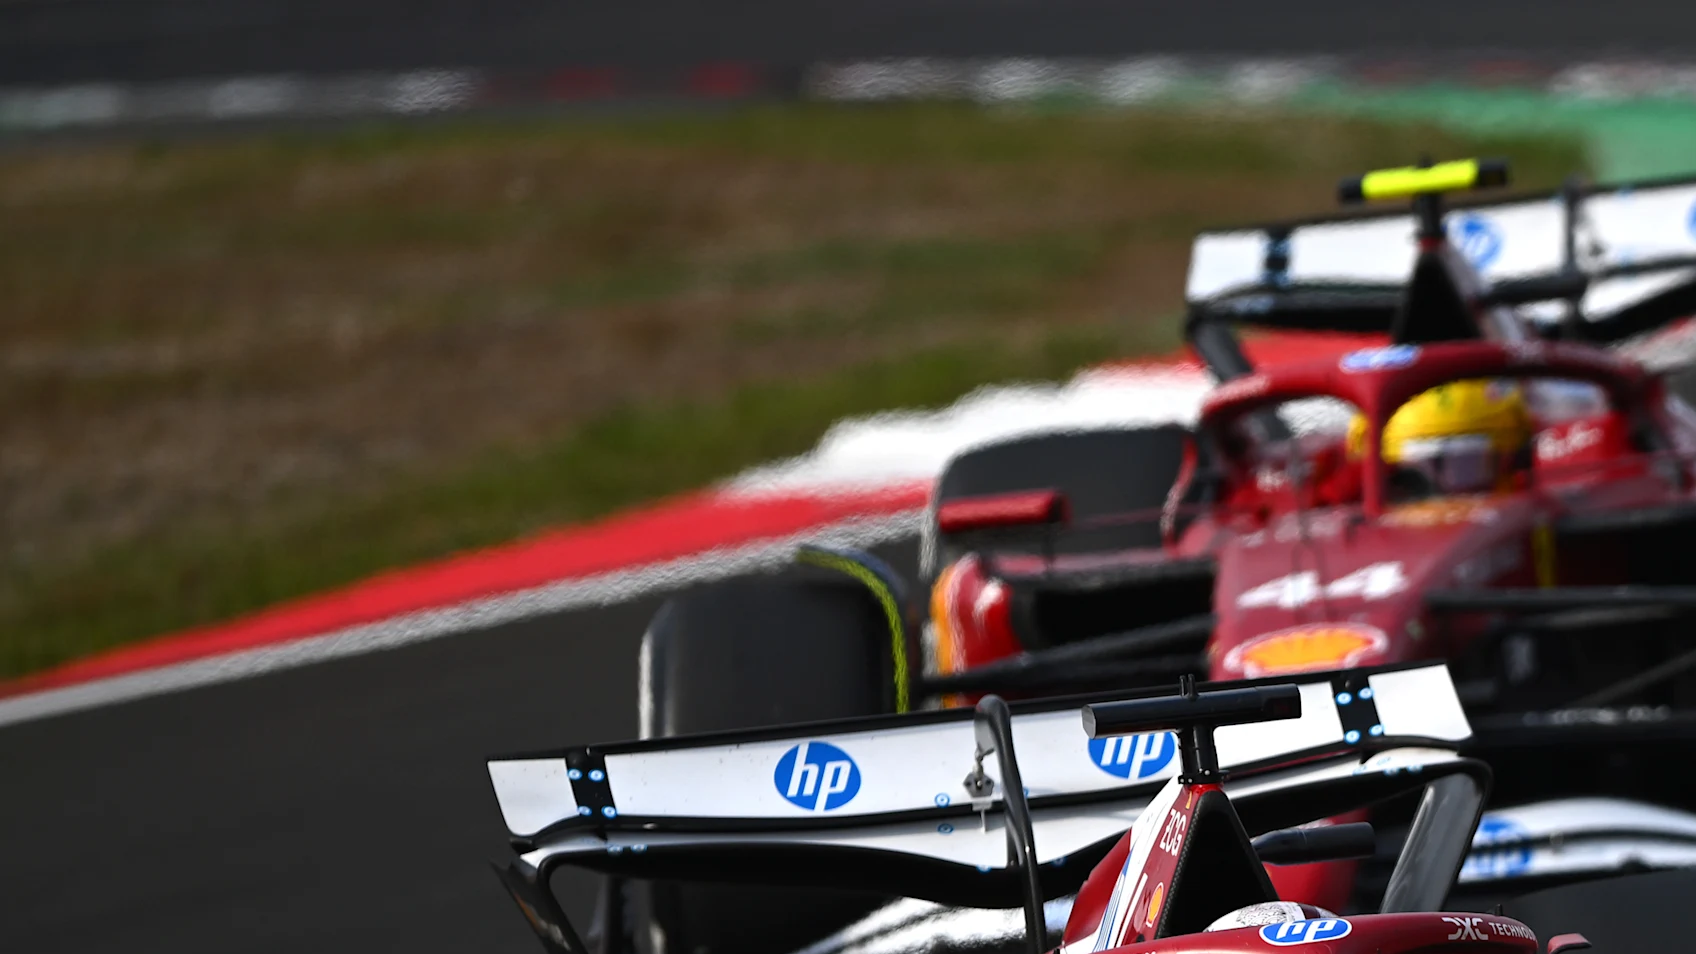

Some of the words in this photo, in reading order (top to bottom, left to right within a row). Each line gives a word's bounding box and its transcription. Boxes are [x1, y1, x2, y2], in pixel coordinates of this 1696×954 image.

[1236, 562, 1407, 608] 44
[786, 739, 852, 812] hp
[1275, 919, 1338, 942] hp
